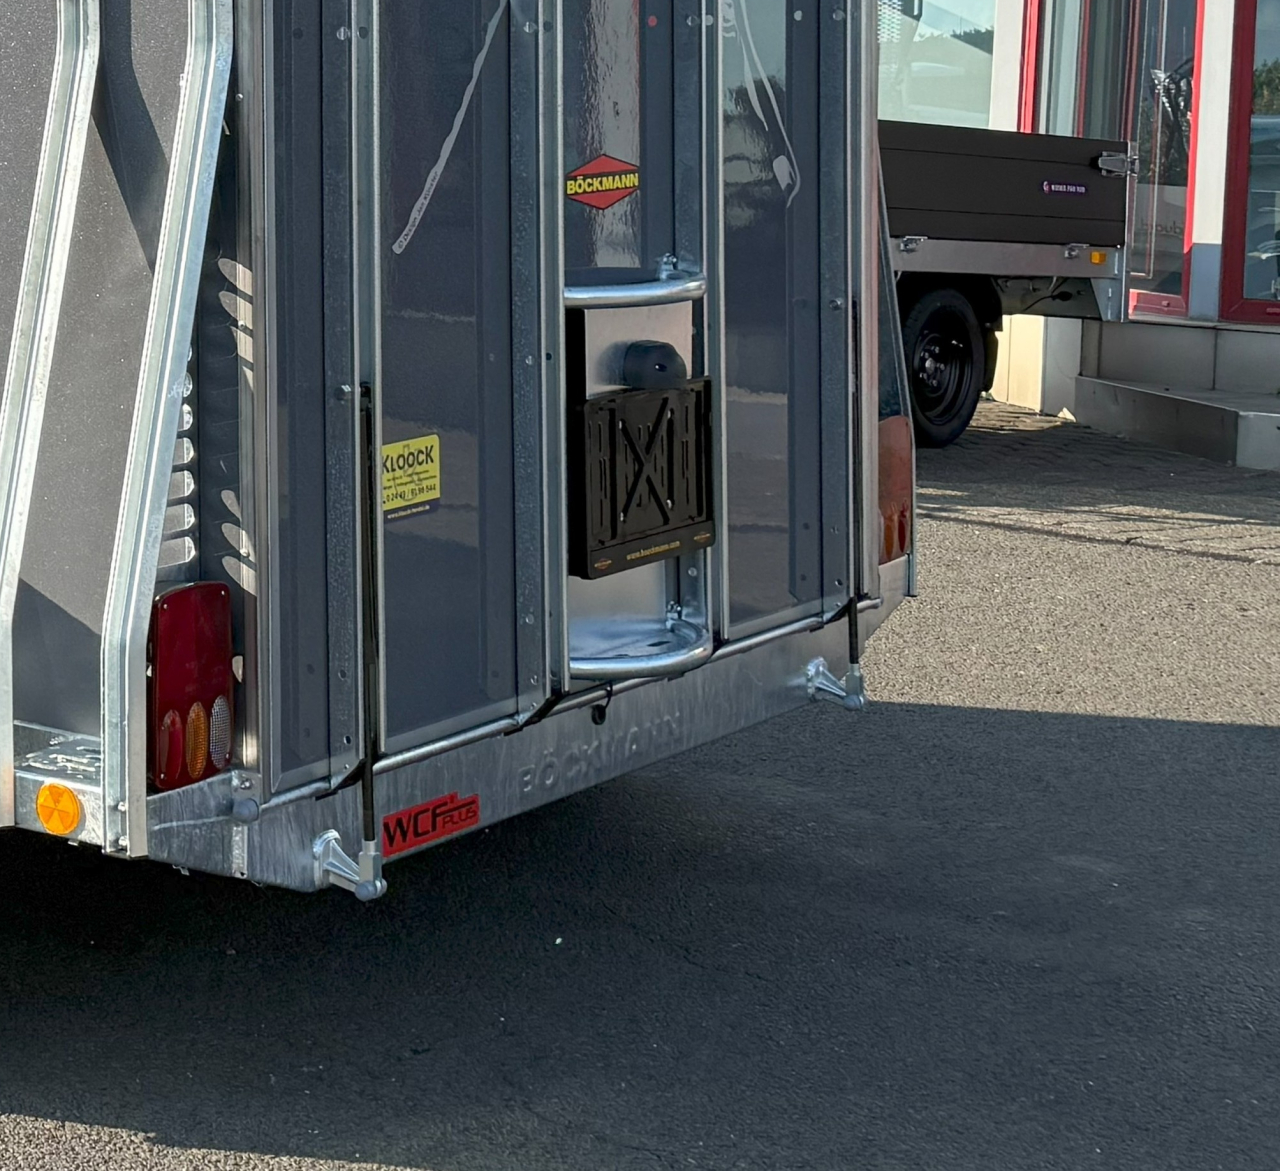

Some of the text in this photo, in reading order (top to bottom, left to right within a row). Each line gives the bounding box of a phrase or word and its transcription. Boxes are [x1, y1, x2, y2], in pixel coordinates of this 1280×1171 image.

[566, 173, 639, 195] BÖCKMANN
[382, 444, 434, 475] KLOOCK
[383, 799, 477, 848] WCF
